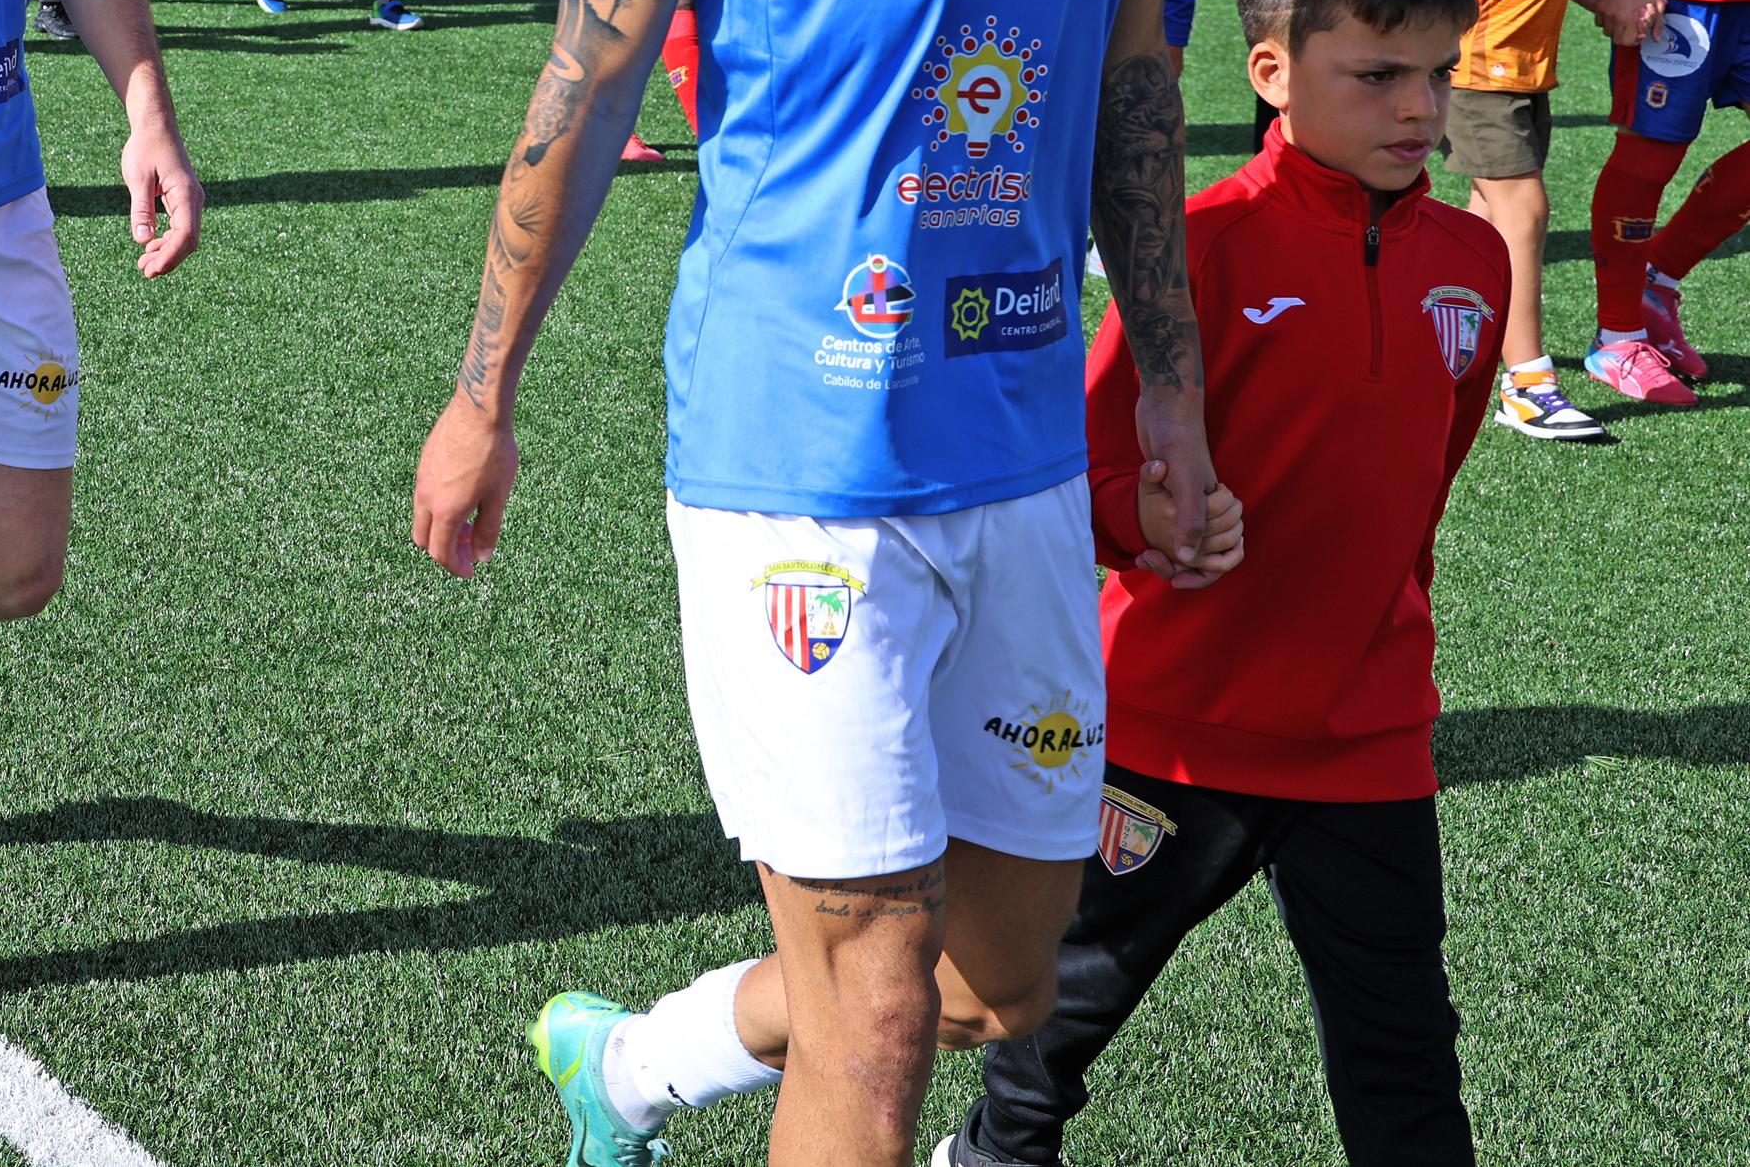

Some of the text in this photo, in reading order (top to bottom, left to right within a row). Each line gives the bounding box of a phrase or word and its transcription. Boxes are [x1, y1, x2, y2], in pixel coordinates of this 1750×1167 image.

[920, 203, 1021, 230] canarias
[995, 273, 1061, 316] Deiland
[1001, 325, 1037, 336] CENTRO
[821, 334, 882, 354] Centros
[885, 340, 903, 354] de
[814, 349, 925, 375] Cultura y Turismo
[823, 373, 864, 389] Cabildo
[866, 378, 882, 390] de
